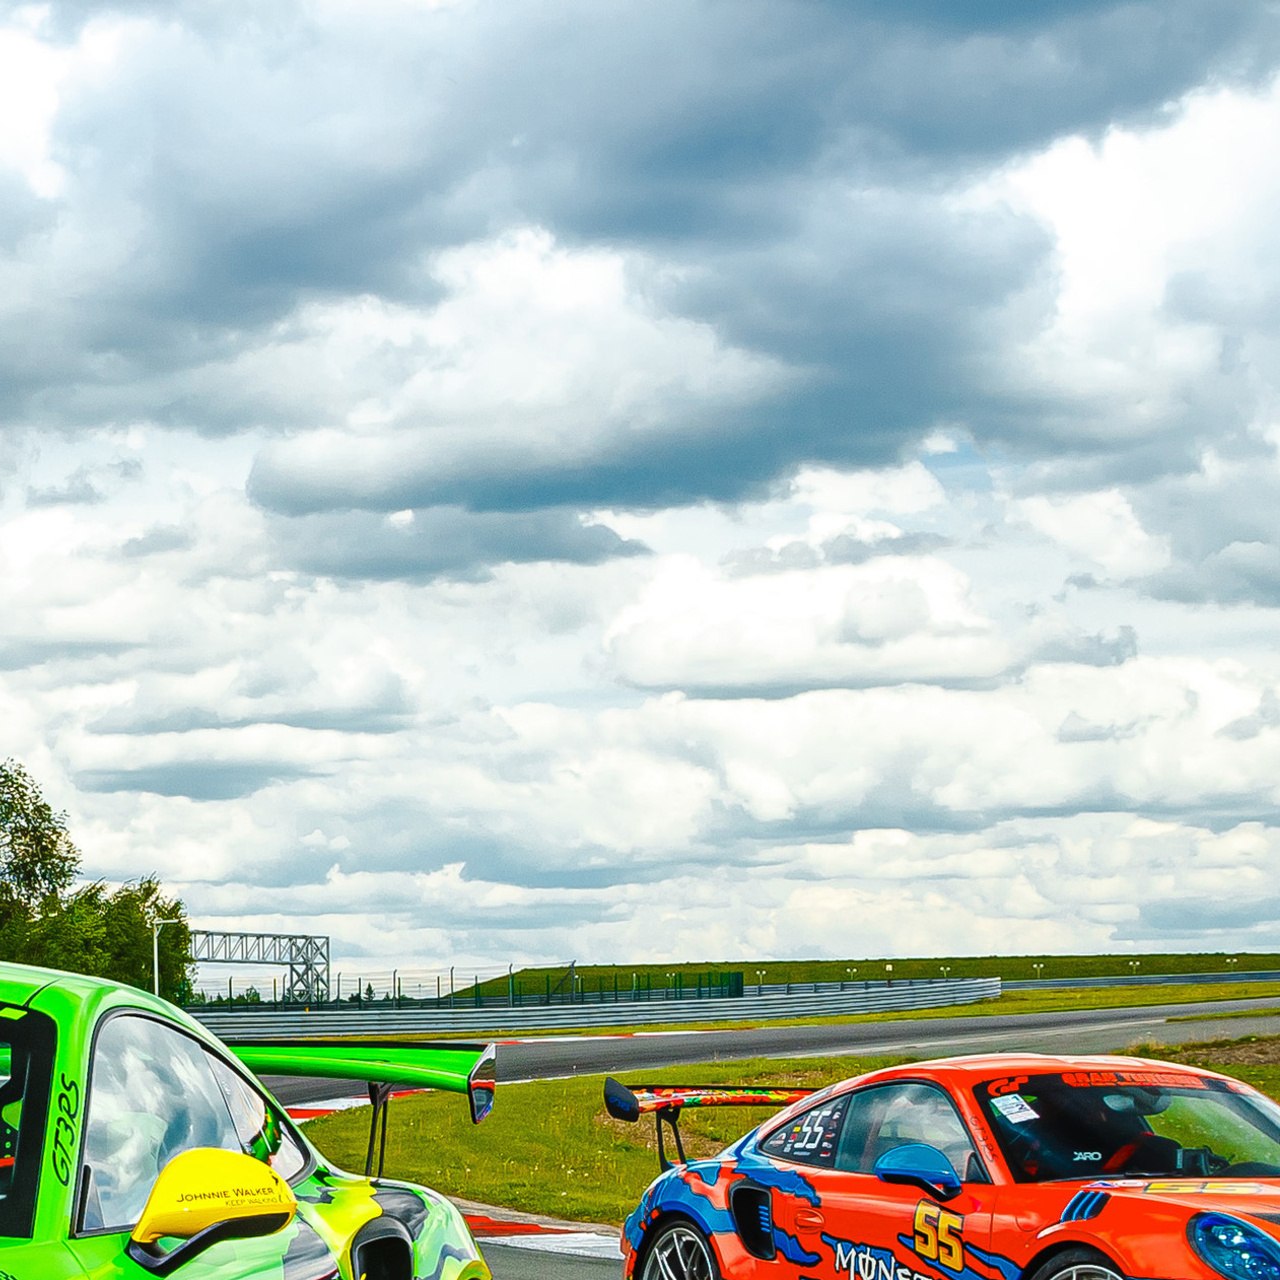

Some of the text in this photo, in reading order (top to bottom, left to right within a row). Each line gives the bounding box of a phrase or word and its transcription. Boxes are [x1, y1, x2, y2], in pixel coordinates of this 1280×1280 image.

[793, 1110, 832, 1149] 55
[176, 1187, 275, 1203] JOHNNIE WALKER
[914, 1199, 965, 1272] 55
